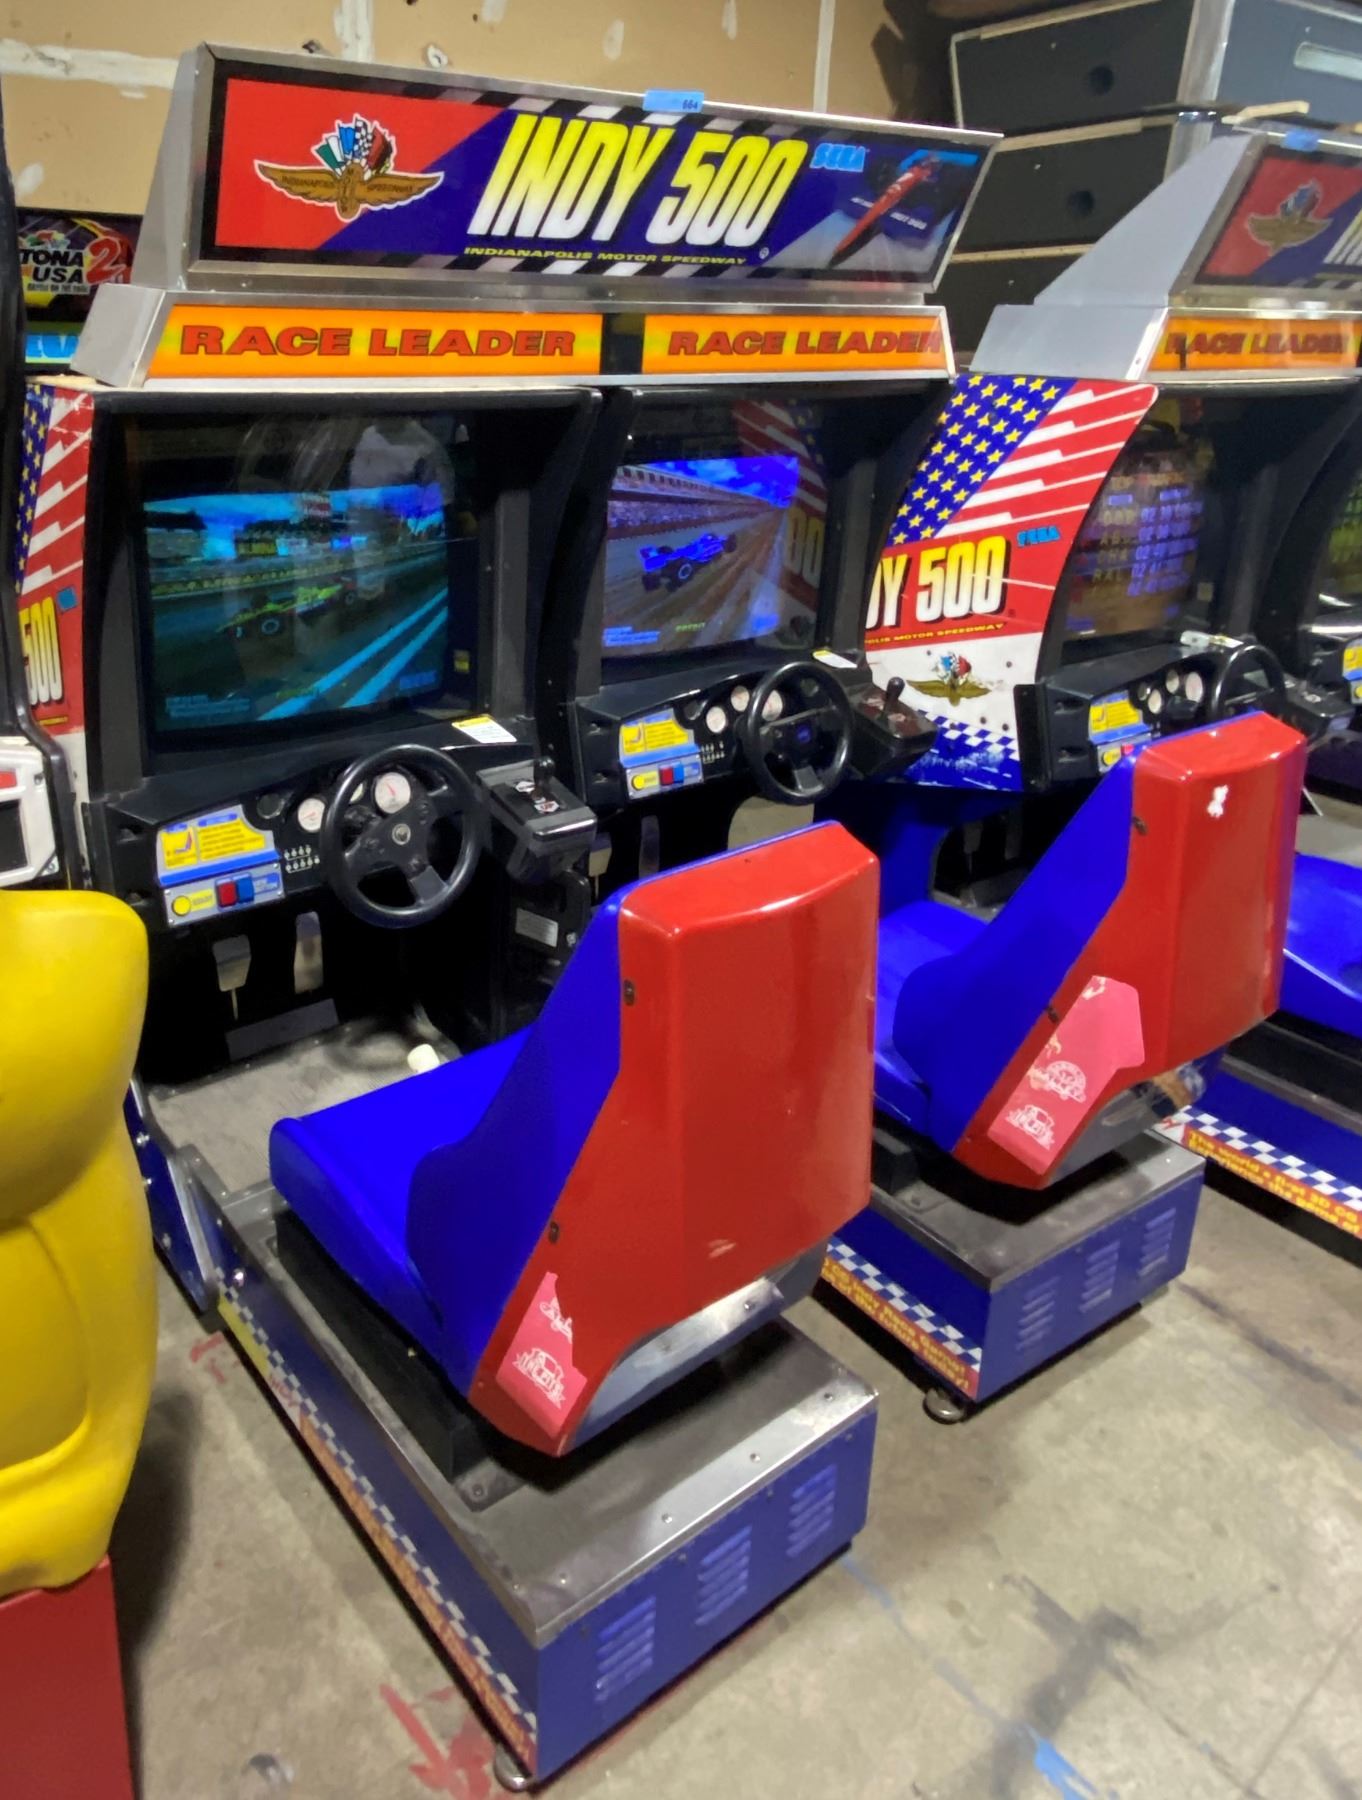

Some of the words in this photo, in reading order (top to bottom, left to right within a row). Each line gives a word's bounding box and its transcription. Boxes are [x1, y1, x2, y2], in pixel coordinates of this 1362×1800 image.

[467, 113, 676, 241] INDY
[645, 130, 809, 248] 500
[32, 266, 84, 284] USA
[85, 237, 127, 286] 2
[464, 246, 594, 261] INDIANAPOLIS
[597, 252, 657, 263] MOTOR
[661, 254, 748, 266] SPEEDWAY
[180, 324, 353, 356] RACE
[368, 328, 576, 357] LEADER
[667, 330, 787, 356] RACE
[795, 330, 943, 355] LEADER
[1164, 332, 1247, 355] RACE
[1249, 332, 1344, 355] LEADER
[915, 535, 1007, 623] 500
[893, 631, 934, 642] MOTOR
[937, 623, 1004, 636] SPEEDWAY
